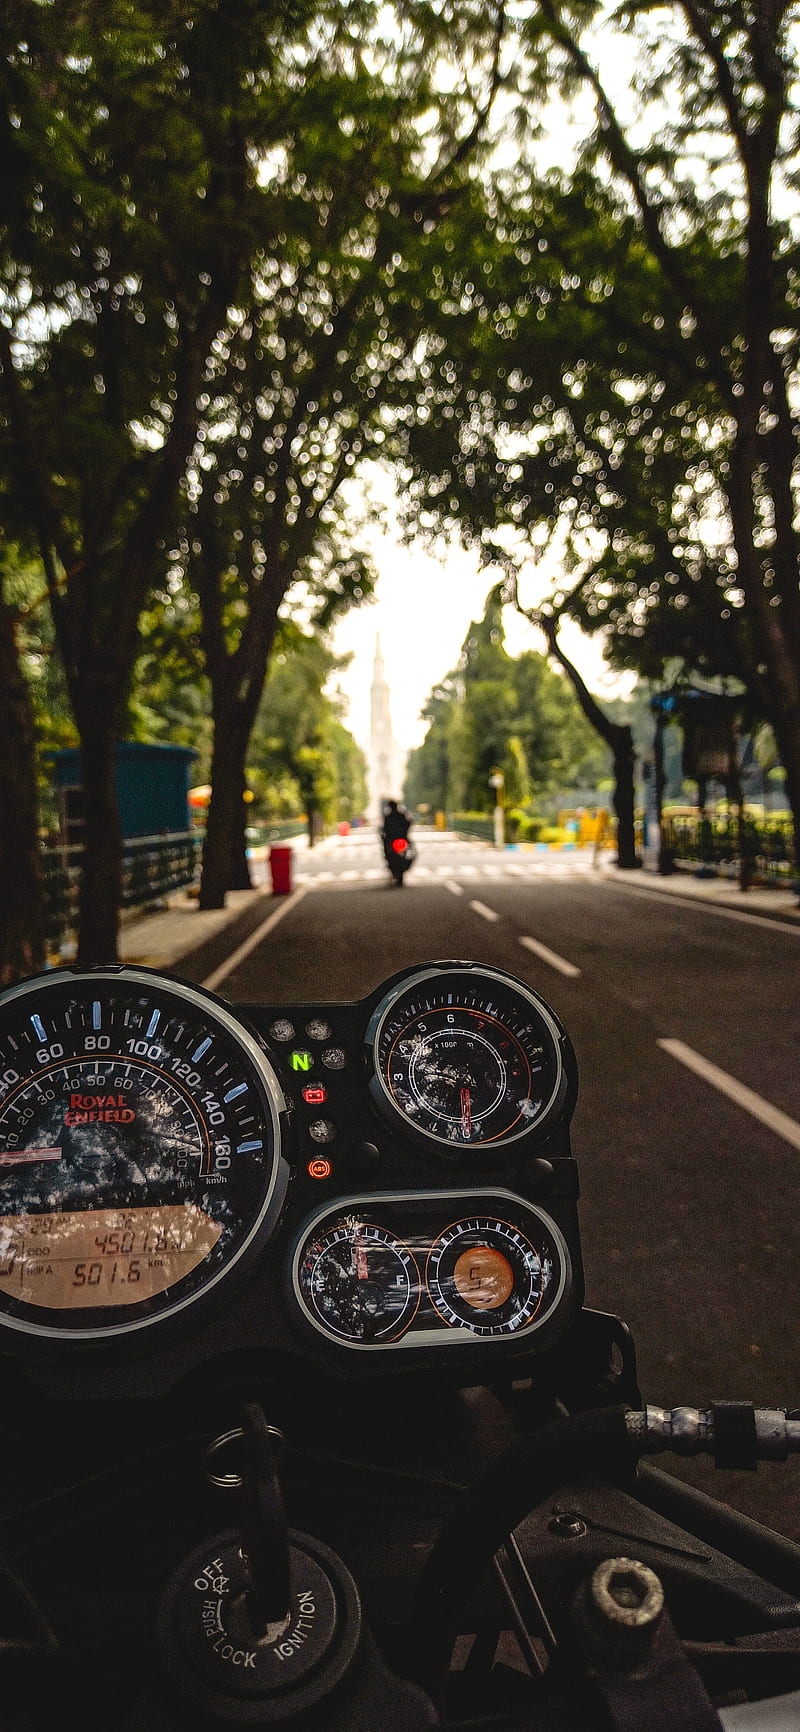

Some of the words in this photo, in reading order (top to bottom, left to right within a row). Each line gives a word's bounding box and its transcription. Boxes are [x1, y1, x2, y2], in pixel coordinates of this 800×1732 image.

[417, 1022, 427, 1032] 5
[446, 1014, 455, 1023] 6
[84, 1035, 111, 1050] 80
[126, 1038, 162, 1060] 100
[398, 1043, 408, 1054] 4
[36, 1044, 64, 1063] 60
[293, 1054, 309, 1071] N
[87, 1075, 106, 1086] 50
[171, 1057, 202, 1088] 120
[393, 1073, 404, 1081] 3
[62, 1079, 81, 1091] 40
[114, 1077, 134, 1090] 60
[37, 1089, 56, 1106] 30
[139, 1085, 157, 1100] 70
[70, 1093, 128, 1110] ROYAL
[201, 1091, 225, 1126] 140
[17, 1107, 35, 1126] 20
[64, 1109, 136, 1127] ENFIELD
[6, 1132, 20, 1149] 10
[214, 1134, 232, 1170] 160
[206, 1176, 228, 1185] km/h
[27, 1246, 51, 1257] ODO
[45, 1265, 53, 1275] A
[72, 1260, 141, 1287] 501.6
[148, 1258, 164, 1268] km
[395, 1275, 405, 1286] F
[194, 1558, 225, 1591] OFF
[201, 1600, 217, 1637] PUSH
[273, 1590, 316, 1661] IGNITION
[212, 1637, 257, 1669] LOCK
